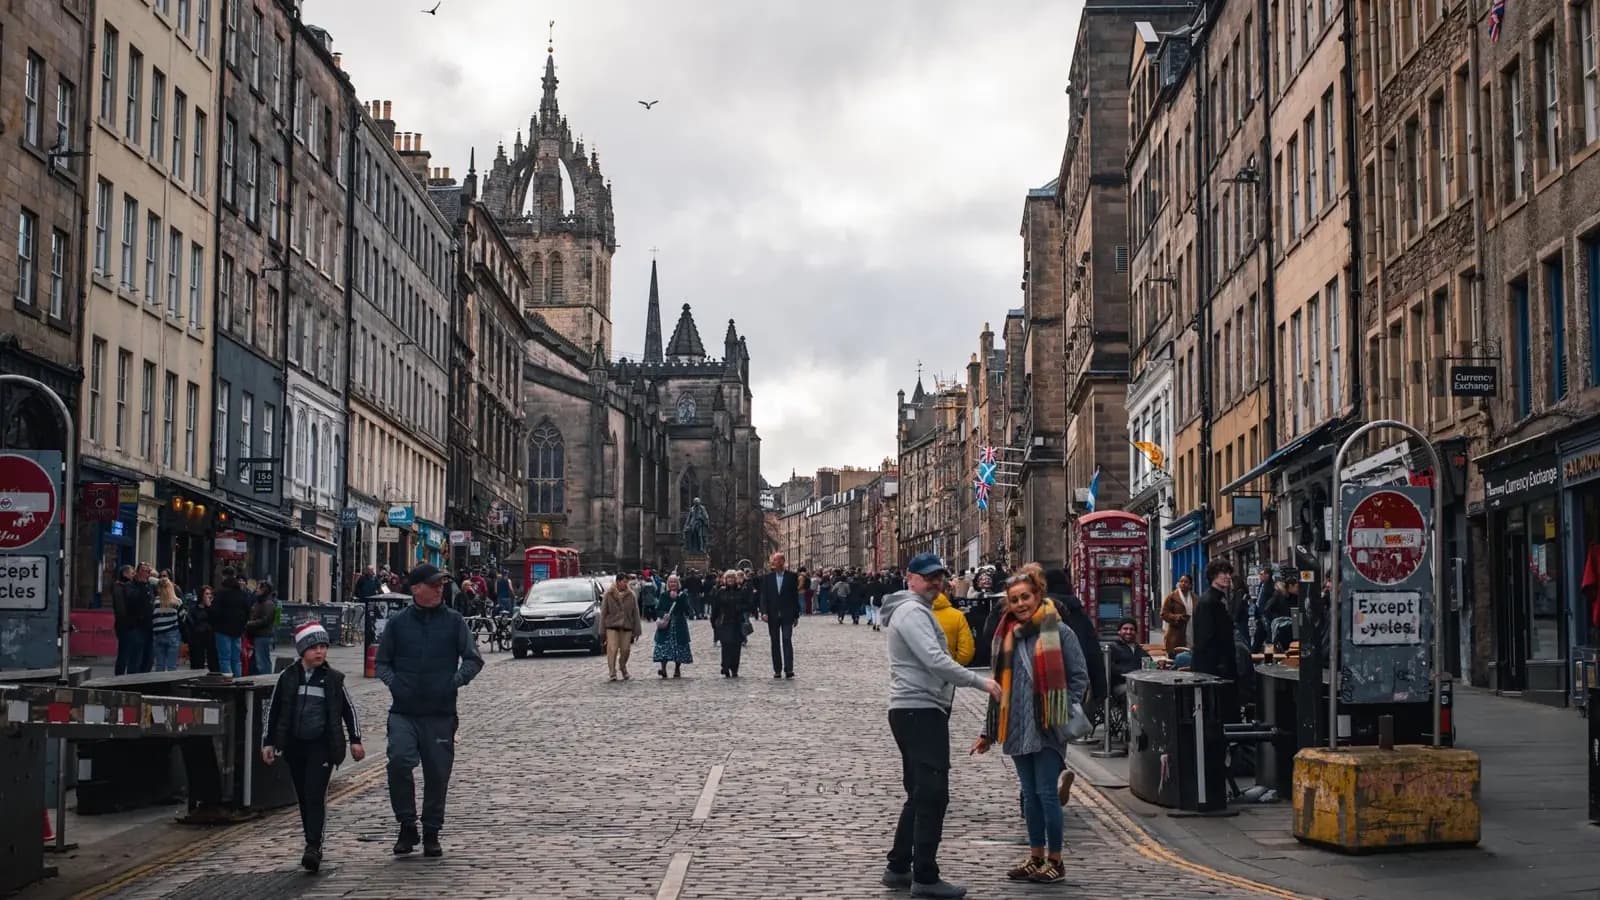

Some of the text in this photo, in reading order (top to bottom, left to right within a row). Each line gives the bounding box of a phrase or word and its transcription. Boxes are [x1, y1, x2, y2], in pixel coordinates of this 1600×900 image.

[1455, 374, 1493, 382] Currency
[1455, 382, 1494, 391] Exchange
[257, 472, 272, 480] 156
[1505, 477, 1529, 494] Currency
[1529, 467, 1557, 487] Exchange
[1359, 599, 1414, 616] Except
